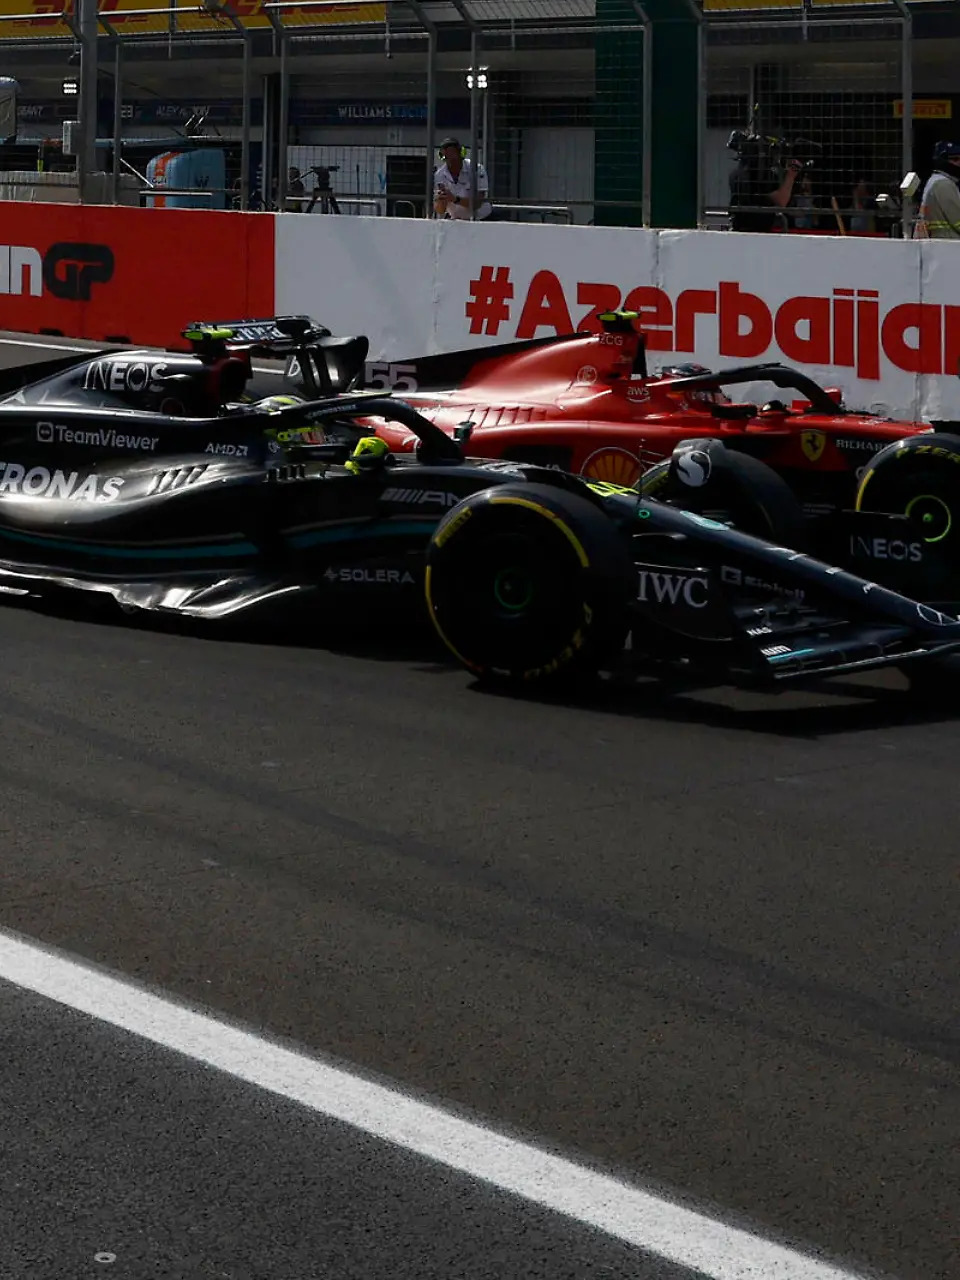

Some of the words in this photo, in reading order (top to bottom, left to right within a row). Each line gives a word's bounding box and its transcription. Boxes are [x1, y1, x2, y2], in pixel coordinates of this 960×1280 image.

[337, 105, 392, 118] WILLIAMS
[466, 266, 960, 381] #Azerbaija
[83, 362, 168, 392] INEOS
[364, 363, 419, 393] 55
[55, 423, 160, 452] TeamViewer
[204, 440, 236, 456] AMD
[836, 438, 888, 453] RICHAR
[850, 534, 923, 563] INEOS
[339, 569, 416, 585] SOLERA
[636, 570, 709, 609] IWC
